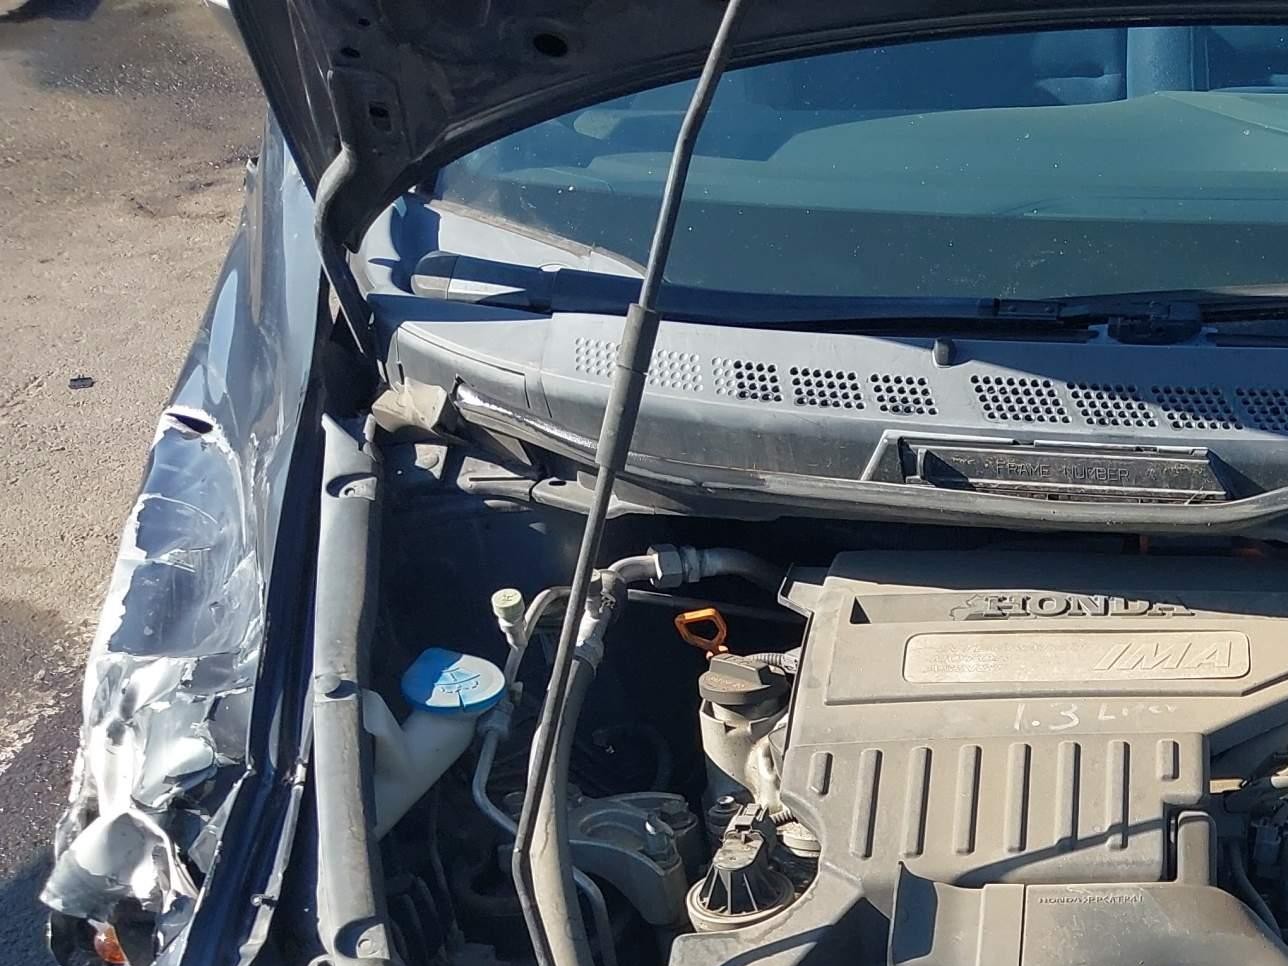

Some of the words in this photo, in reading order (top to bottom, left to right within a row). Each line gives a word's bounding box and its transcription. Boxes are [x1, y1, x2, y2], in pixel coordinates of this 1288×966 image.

[996, 462, 1051, 479] FRAME
[1063, 466, 1131, 483] NUMBER
[981, 594, 1197, 617] HONDA
[1093, 639, 1233, 671] IMA
